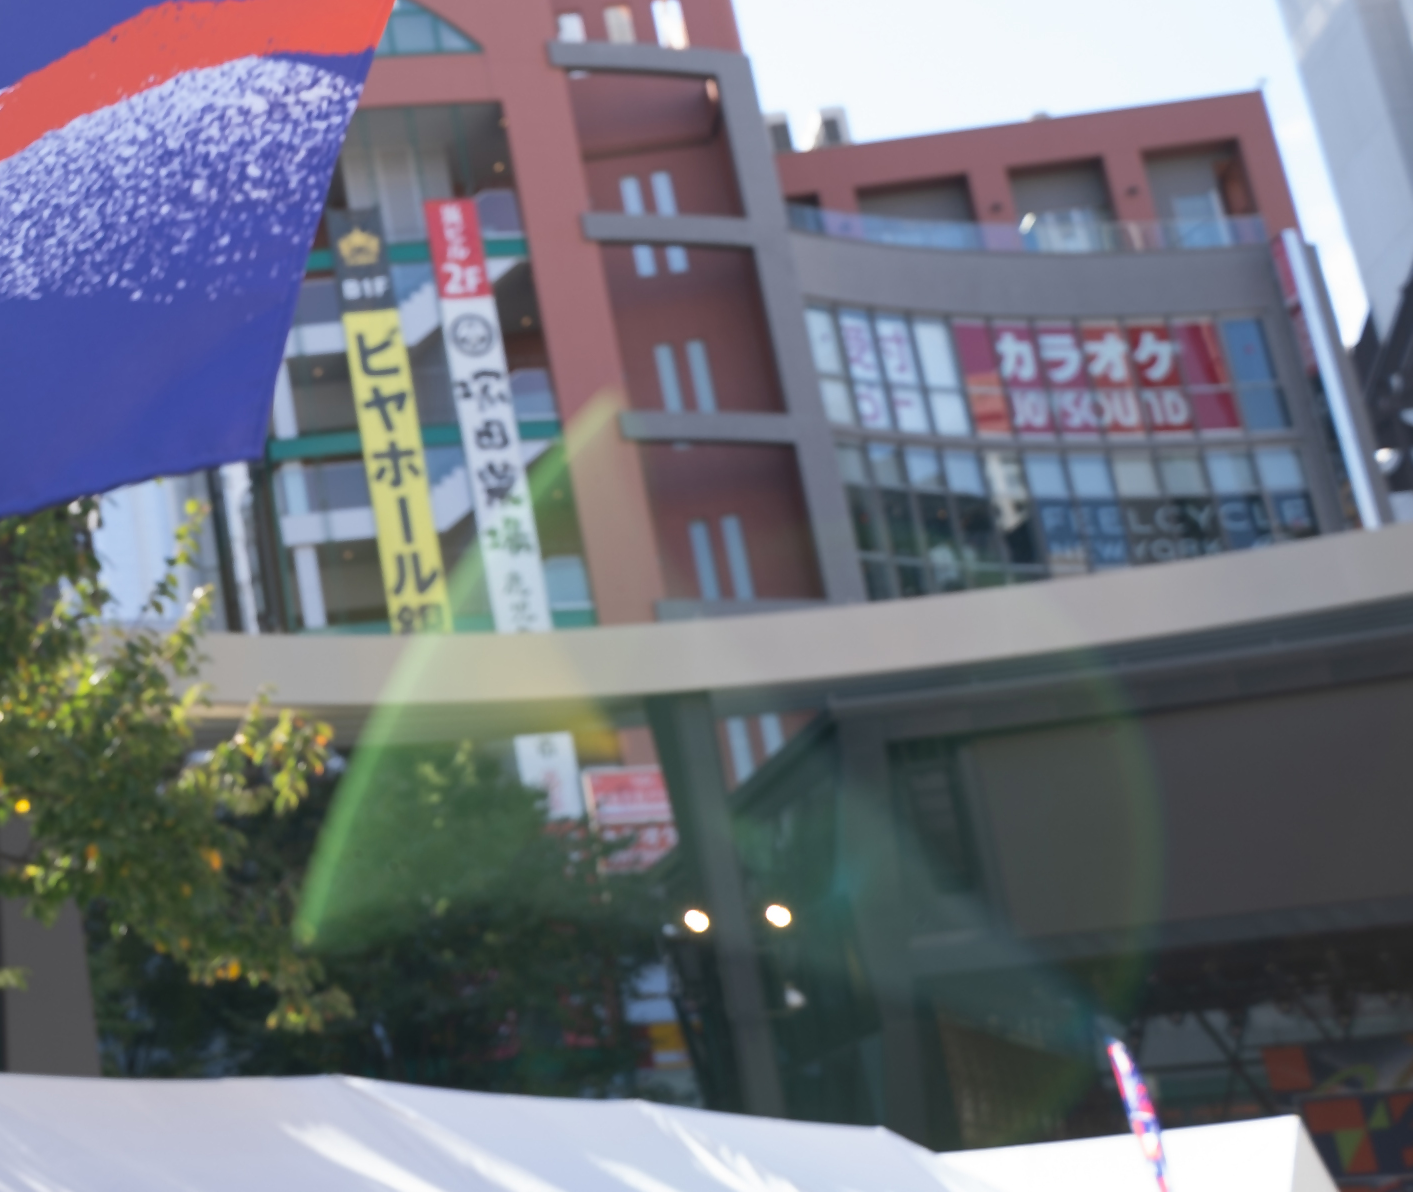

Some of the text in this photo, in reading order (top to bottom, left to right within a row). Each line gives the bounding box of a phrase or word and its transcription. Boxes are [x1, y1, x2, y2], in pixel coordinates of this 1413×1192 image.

[441, 262, 482, 295] 2F
[996, 331, 1179, 383] カラオケ
[1011, 389, 1190, 428] JOSOUD
